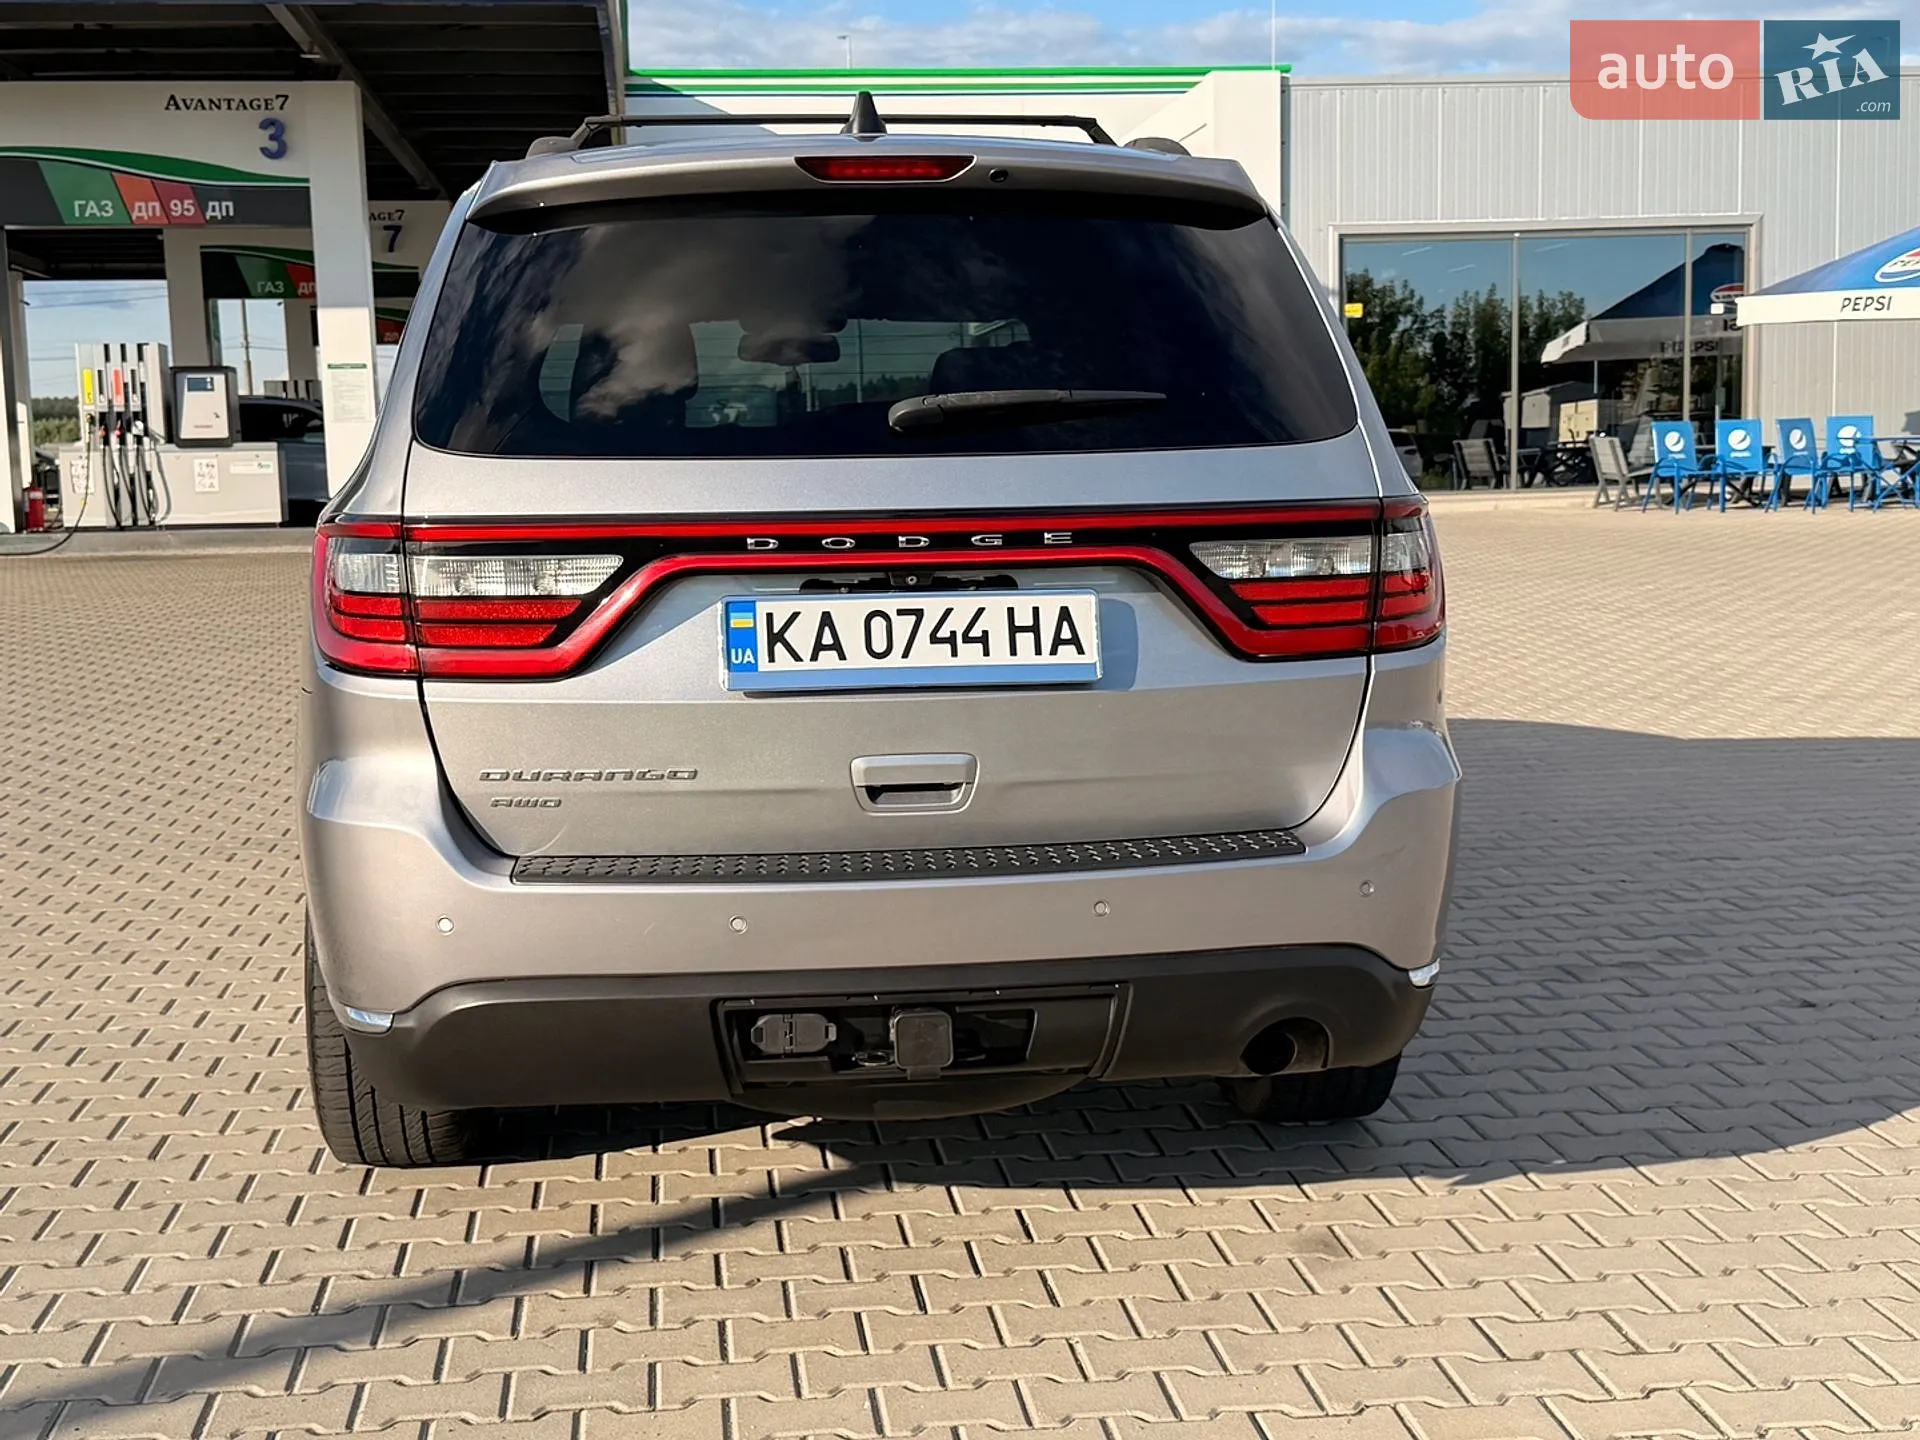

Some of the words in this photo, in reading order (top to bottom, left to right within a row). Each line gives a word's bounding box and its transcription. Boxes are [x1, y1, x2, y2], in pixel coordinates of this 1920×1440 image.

[258, 117, 289, 161] 3
[73, 200, 115, 218] ГАЗ
[169, 200, 196, 217] 95
[382, 224, 403, 253] 7
[256, 281, 285, 294] ГАЗ
[1840, 295, 1893, 314] PEPSI
[746, 531, 1073, 550] DODGE
[730, 647, 756, 665] UA
[764, 610, 848, 664] KA
[863, 606, 991, 661] 0744
[1006, 604, 1087, 657] HA
[479, 767, 698, 783] DURANGO
[490, 797, 562, 809] AWD
